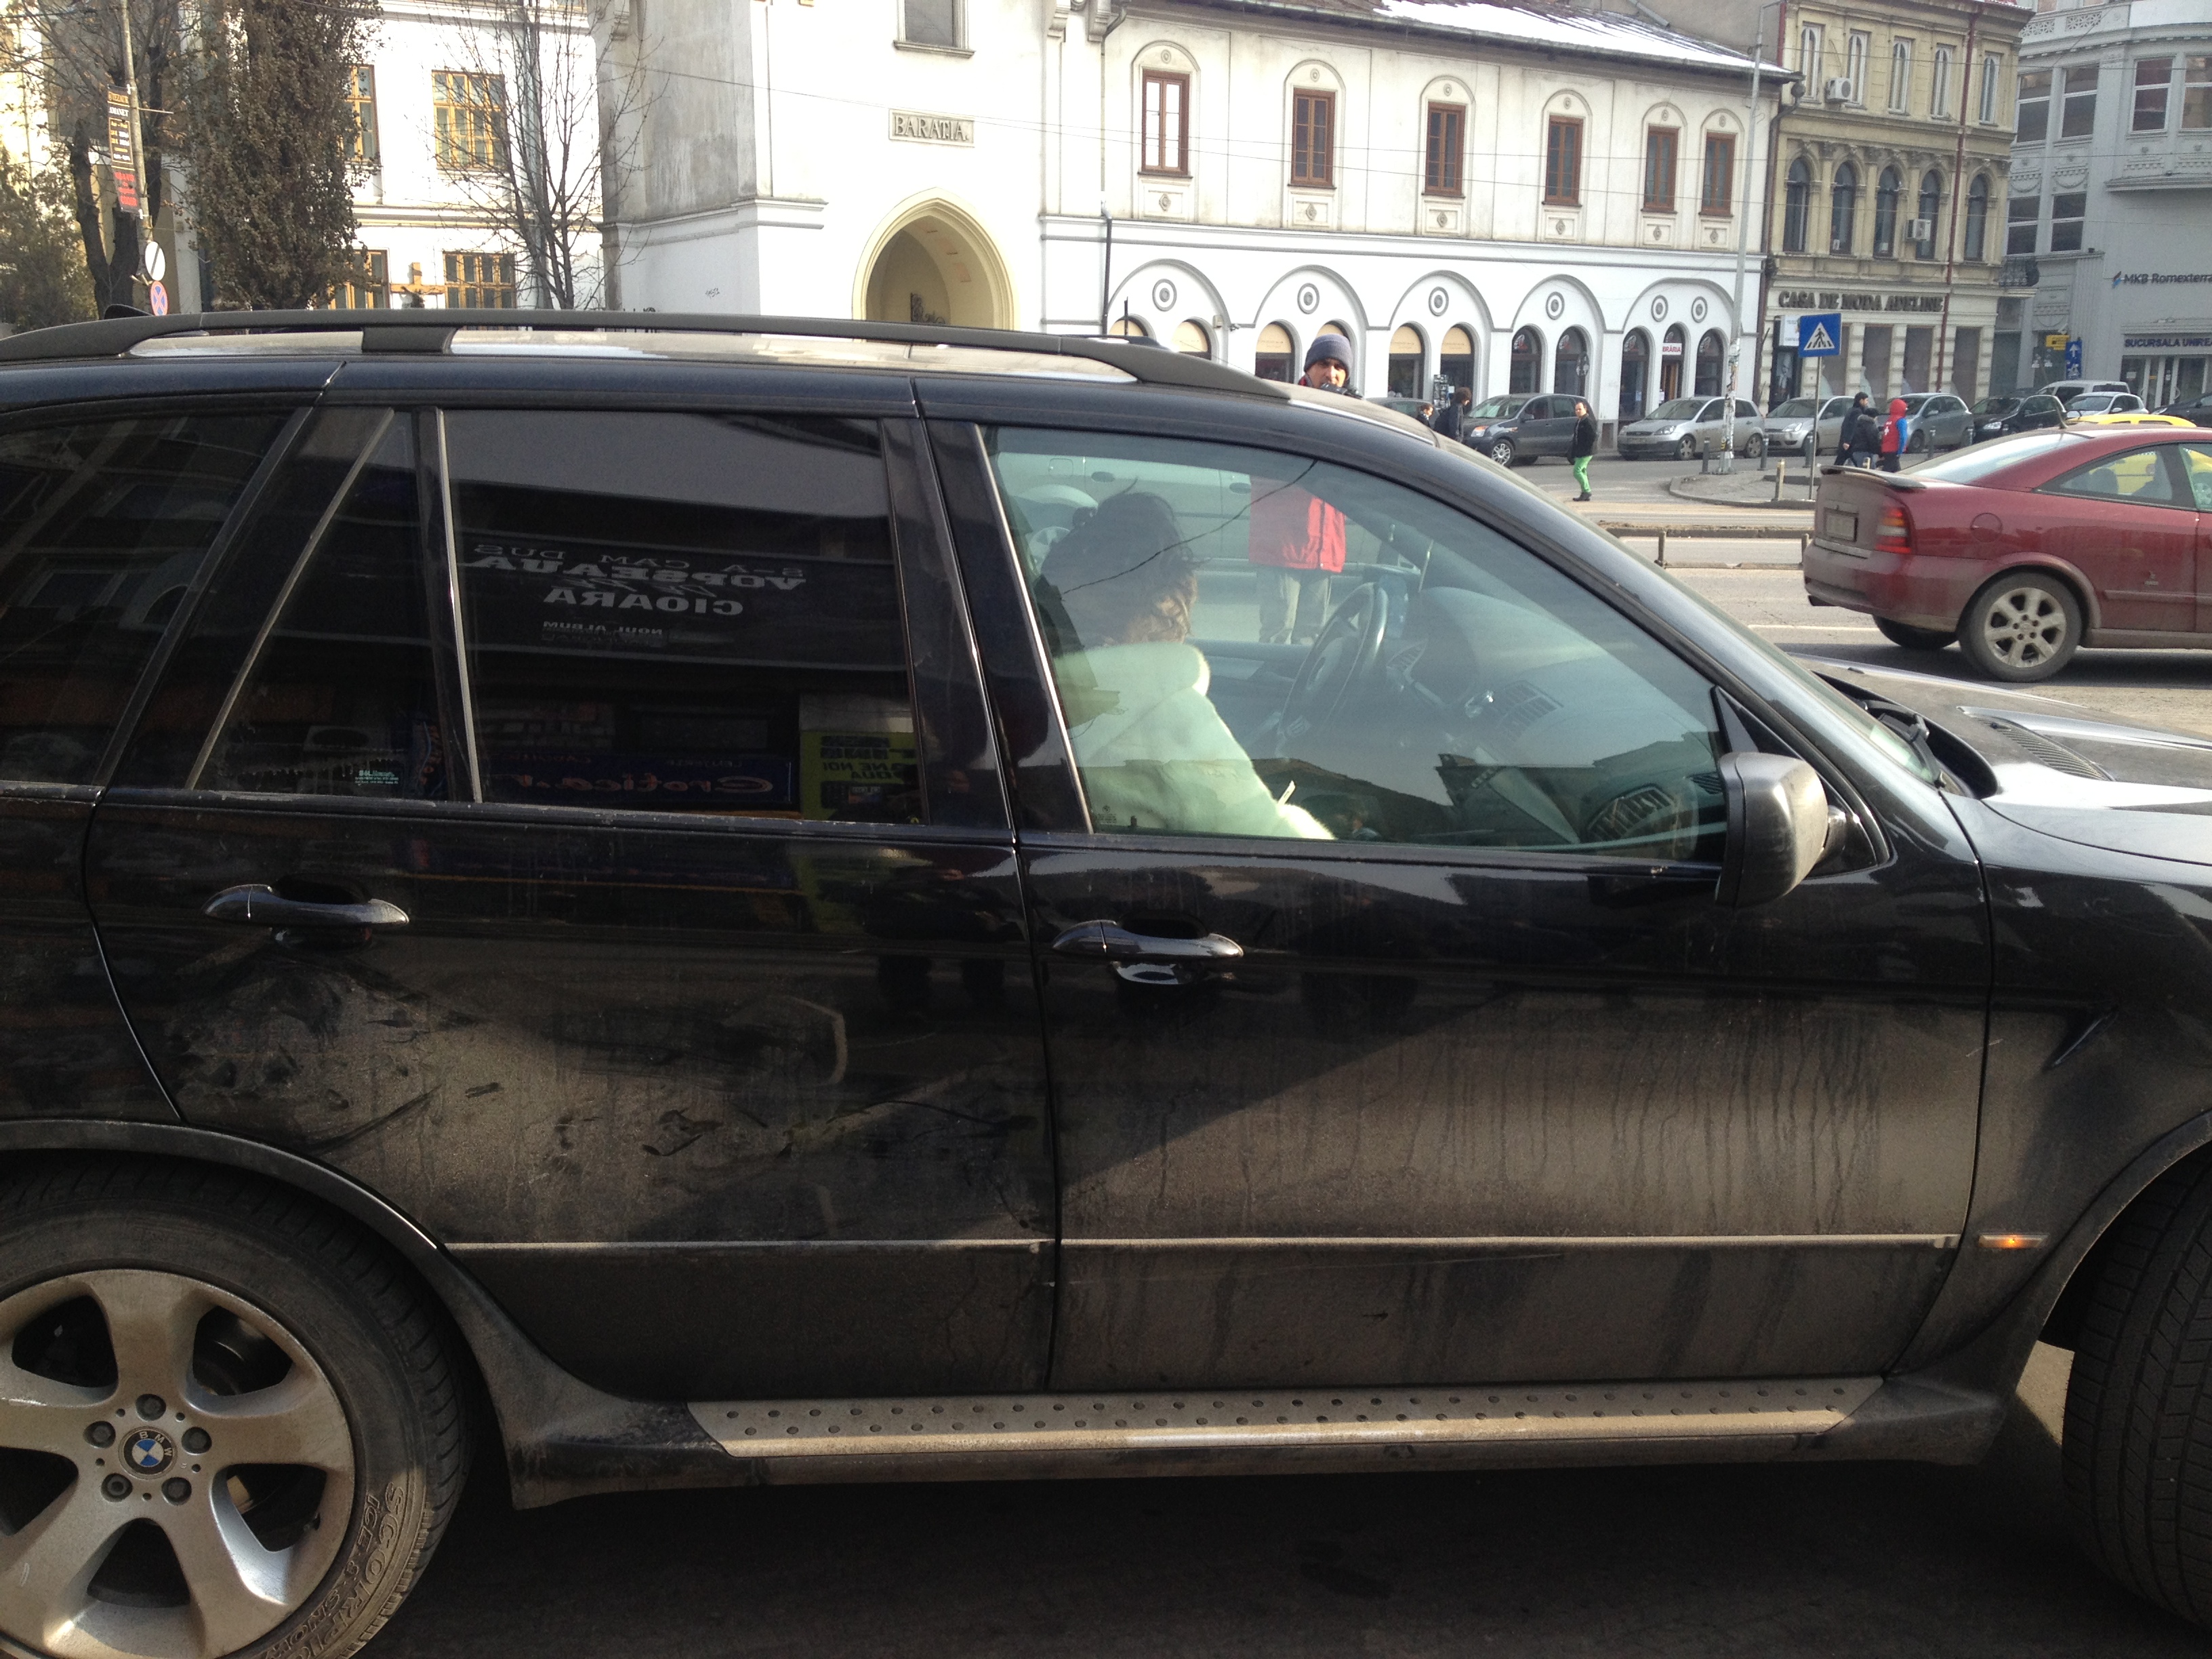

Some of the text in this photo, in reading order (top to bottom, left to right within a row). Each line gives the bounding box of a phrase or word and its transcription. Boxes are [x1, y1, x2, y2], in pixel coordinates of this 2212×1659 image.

[2124, 274, 2148, 284] MKB
[1778, 291, 1944, 312] CASA DE MODA ADELINE
[2125, 339, 2180, 347] SUCURSALA
[139, 1431, 173, 1456] BMW
